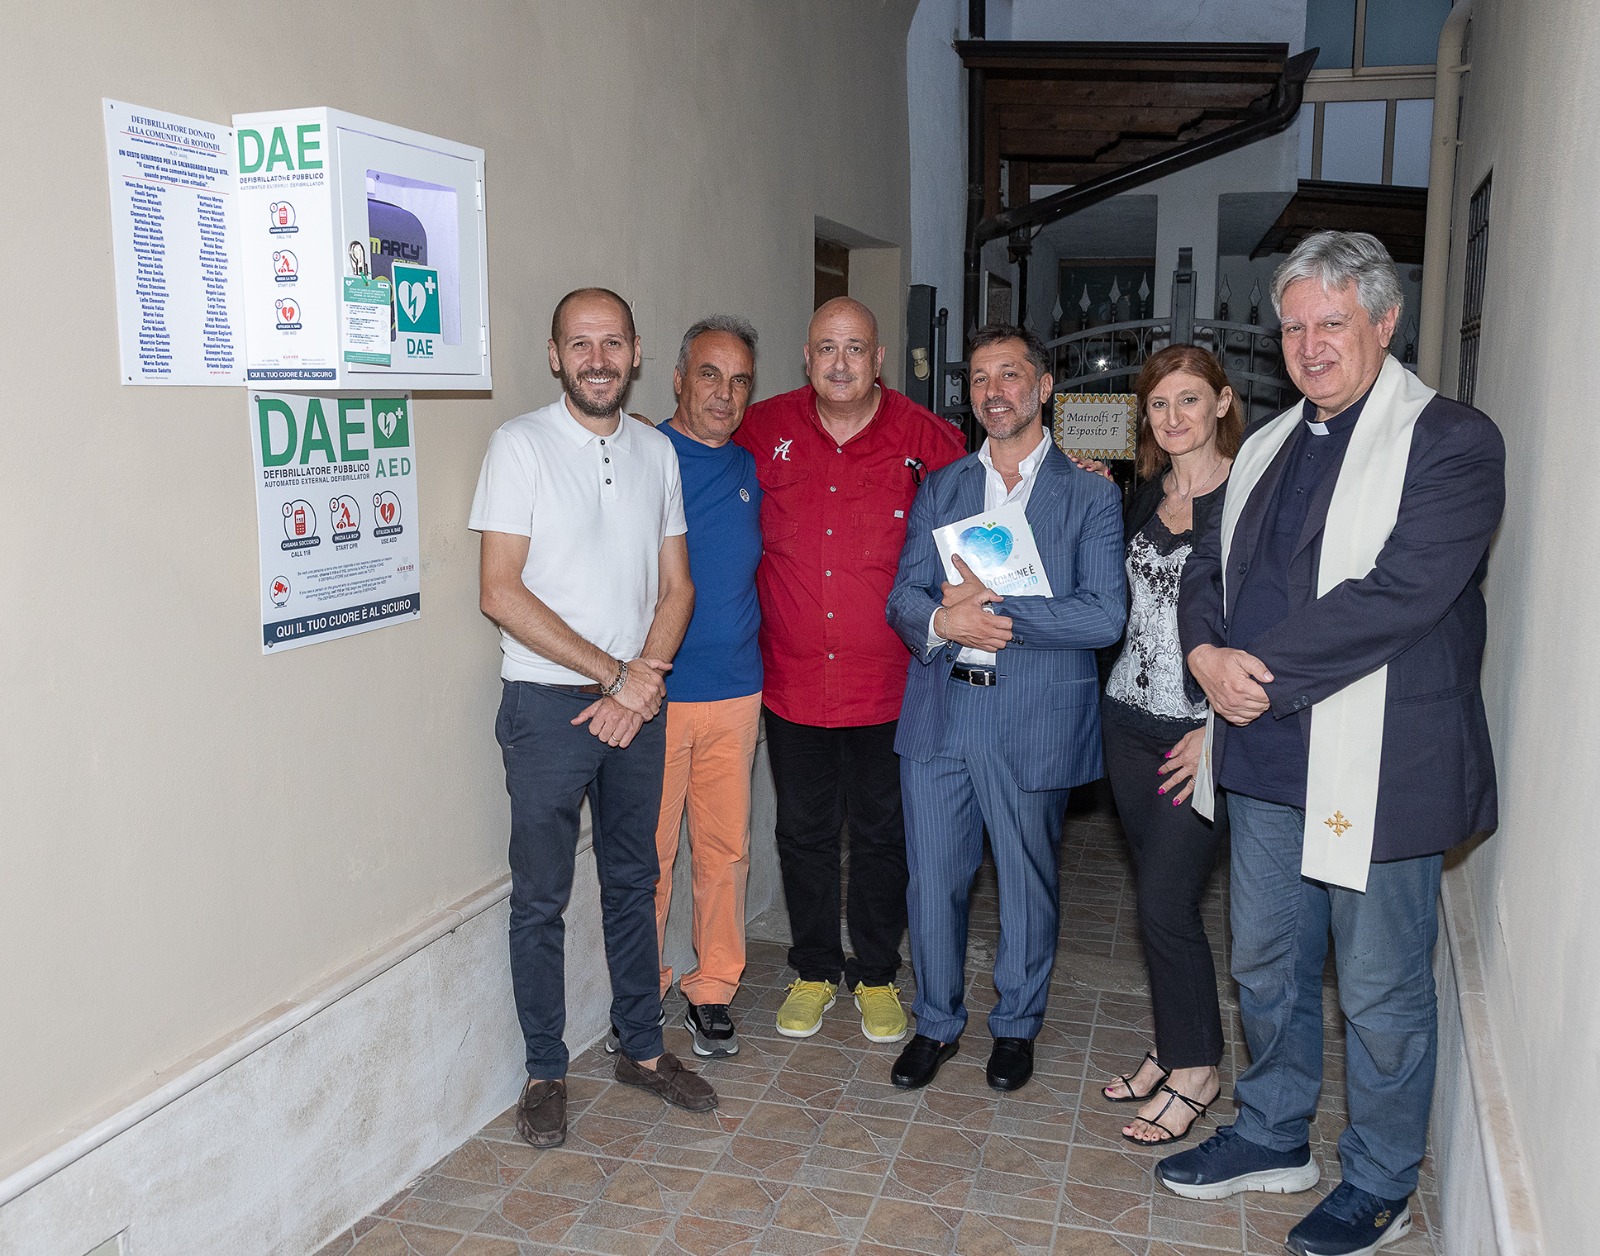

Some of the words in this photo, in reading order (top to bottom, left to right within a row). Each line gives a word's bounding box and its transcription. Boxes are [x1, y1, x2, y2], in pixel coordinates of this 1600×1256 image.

[127, 125, 144, 135] ALLA
[191, 138, 220, 151] ROTONDI
[131, 115, 187, 134] DEFIBRILLATORE
[188, 128, 215, 140] DONATO
[237, 124, 323, 174] DAE
[127, 151, 139, 159] GESTO
[141, 153, 162, 163] GENEROSO
[178, 160, 207, 172] SALVAGUARDIA
[144, 171, 159, 180] quando
[160, 174, 178, 184] protegge
[240, 175, 290, 184] DEFIBRILLATORE
[407, 338, 433, 355] DAE
[1067, 411, 1109, 426] Mainolfi
[1112, 412, 1123, 422] T.
[258, 398, 369, 467] DAE
[1067, 426, 1107, 439] Esposito
[1110, 427, 1119, 436] F.
[773, 438, 793, 461] A
[264, 466, 331, 479] DEFIBRILLATORE
[334, 463, 370, 474] PUBBLICO
[375, 457, 411, 478] AED
[264, 479, 299, 488] AUTOMATED
[302, 476, 329, 485] EXTERNAL
[331, 473, 370, 482] DEFIBRILLATOR
[994, 568, 1029, 586] COMUNE
[1029, 564, 1035, 574] È
[276, 624, 294, 637] QUI
[296, 623, 305, 633] IL
[307, 618, 326, 631] TUO
[329, 613, 360, 627] CUORE
[362, 607, 367, 619] È
[369, 606, 380, 618] AL
[381, 599, 411, 615] SICURO
